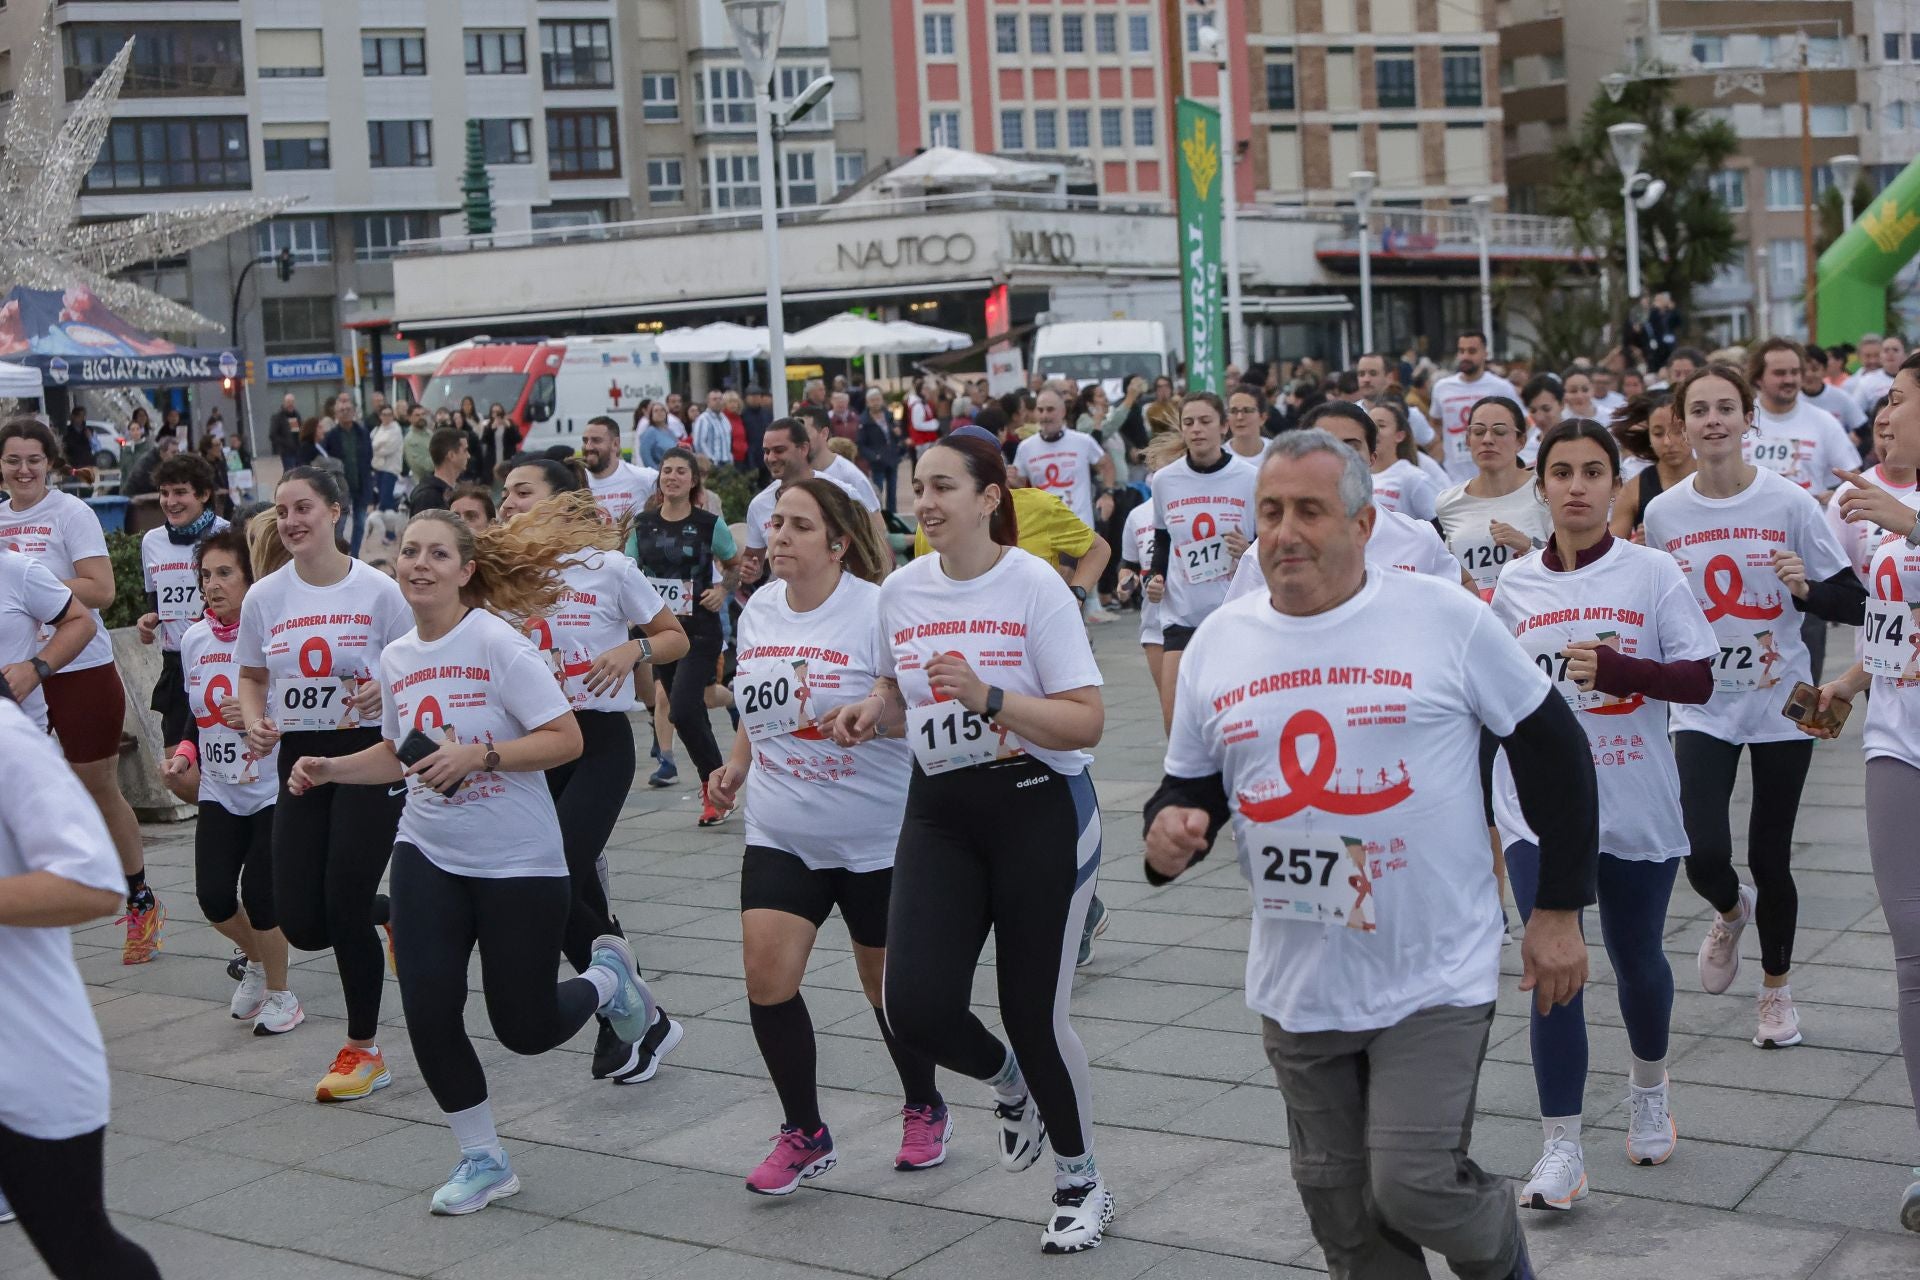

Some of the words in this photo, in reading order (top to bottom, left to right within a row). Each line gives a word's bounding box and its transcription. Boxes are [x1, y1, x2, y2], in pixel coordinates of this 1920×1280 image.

[82, 356, 212, 382] BICIAVENTURAS
[1754, 444, 1788, 461] 019
[1684, 527, 1730, 547] CARRERA
[1732, 527, 1786, 544] ANTI-SIDA
[160, 561, 188, 572] CARRERA
[1187, 542, 1222, 568] 217
[1463, 544, 1507, 570] 120
[162, 585, 197, 604] 237
[286, 613, 328, 630] CARRERA
[1528, 607, 1580, 630] CARRERA
[1583, 606, 1645, 628] ANTI-SIDA
[1865, 610, 1905, 647] 074
[893, 626, 915, 646] XXIV
[916, 619, 966, 639] CARRERA
[969, 619, 1028, 639] ANTI-SIDA
[200, 652, 233, 665] CARRERA
[754, 645, 795, 658] CARRERA
[796, 646, 850, 667] ANTI-SIDA
[1535, 652, 1572, 683] 07
[1709, 645, 1753, 670] 72
[404, 666, 438, 688] CARRERA
[439, 665, 491, 682] ANTI-SIDA
[284, 685, 337, 710] 087
[742, 676, 789, 715] 260
[1213, 685, 1246, 714] XXIV
[1249, 667, 1323, 697] CARRERA
[1327, 666, 1414, 690] ANTI-SIDA
[920, 710, 983, 751] 115
[205, 741, 237, 764] 065
[1016, 773, 1050, 789] adidas
[1261, 845, 1340, 888] 257
